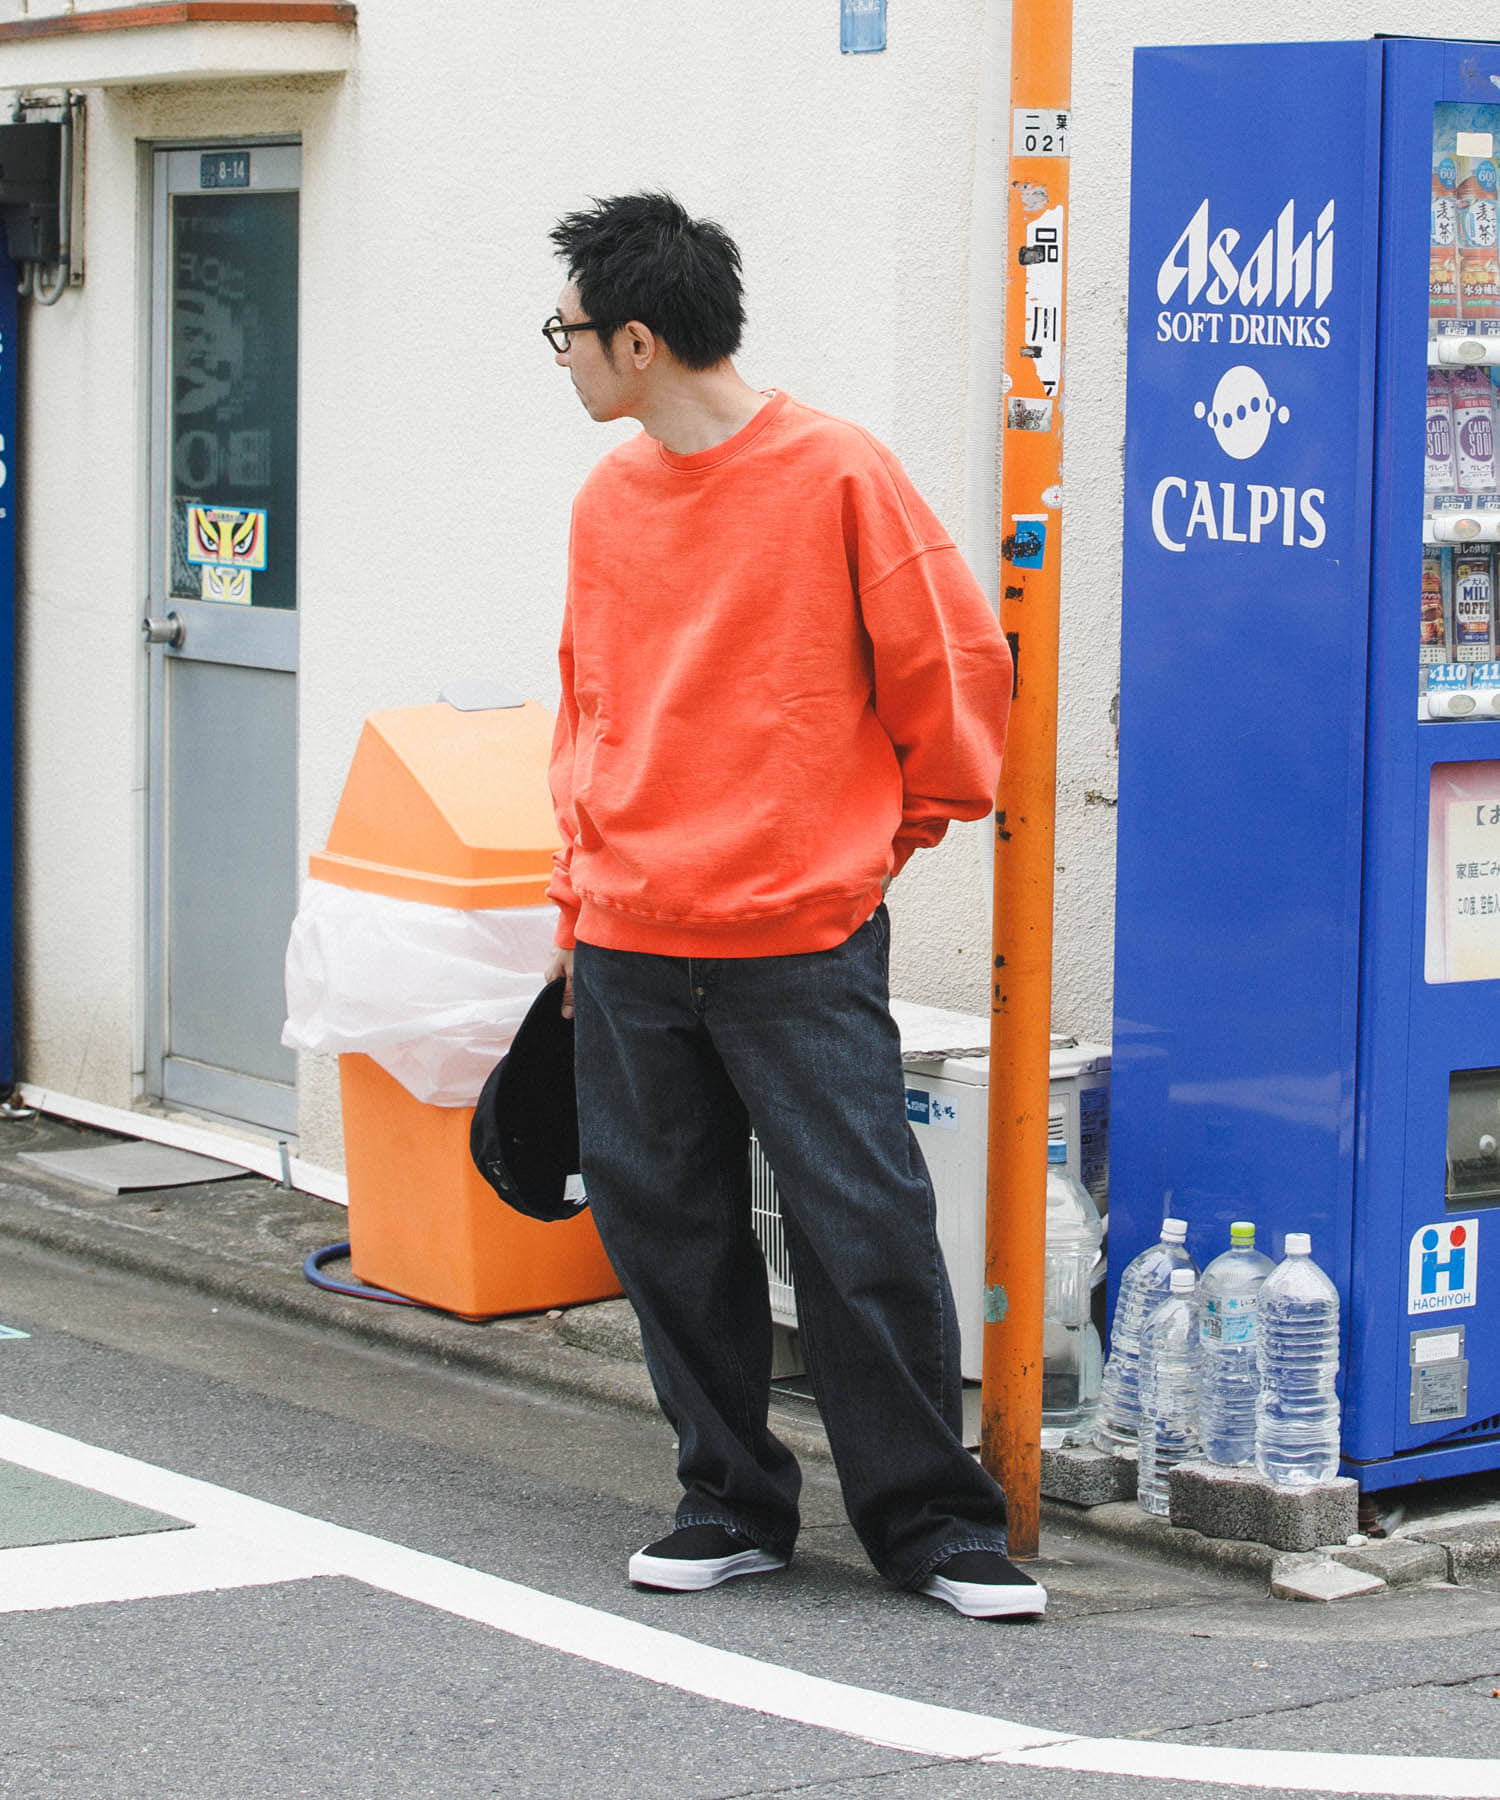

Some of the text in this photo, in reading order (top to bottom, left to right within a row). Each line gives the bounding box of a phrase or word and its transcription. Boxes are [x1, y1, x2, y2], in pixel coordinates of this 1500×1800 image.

[1025, 135, 1065, 152] 021
[219, 160, 244, 179] 8-14
[1157, 197, 1335, 309] Asahi
[1156, 311, 1331, 348] SOFT DRINKS
[1151, 475, 1327, 552] CALPIS
[1429, 664, 1467, 682] ¥110
[1413, 1293, 1471, 1311] HACHIYOH
